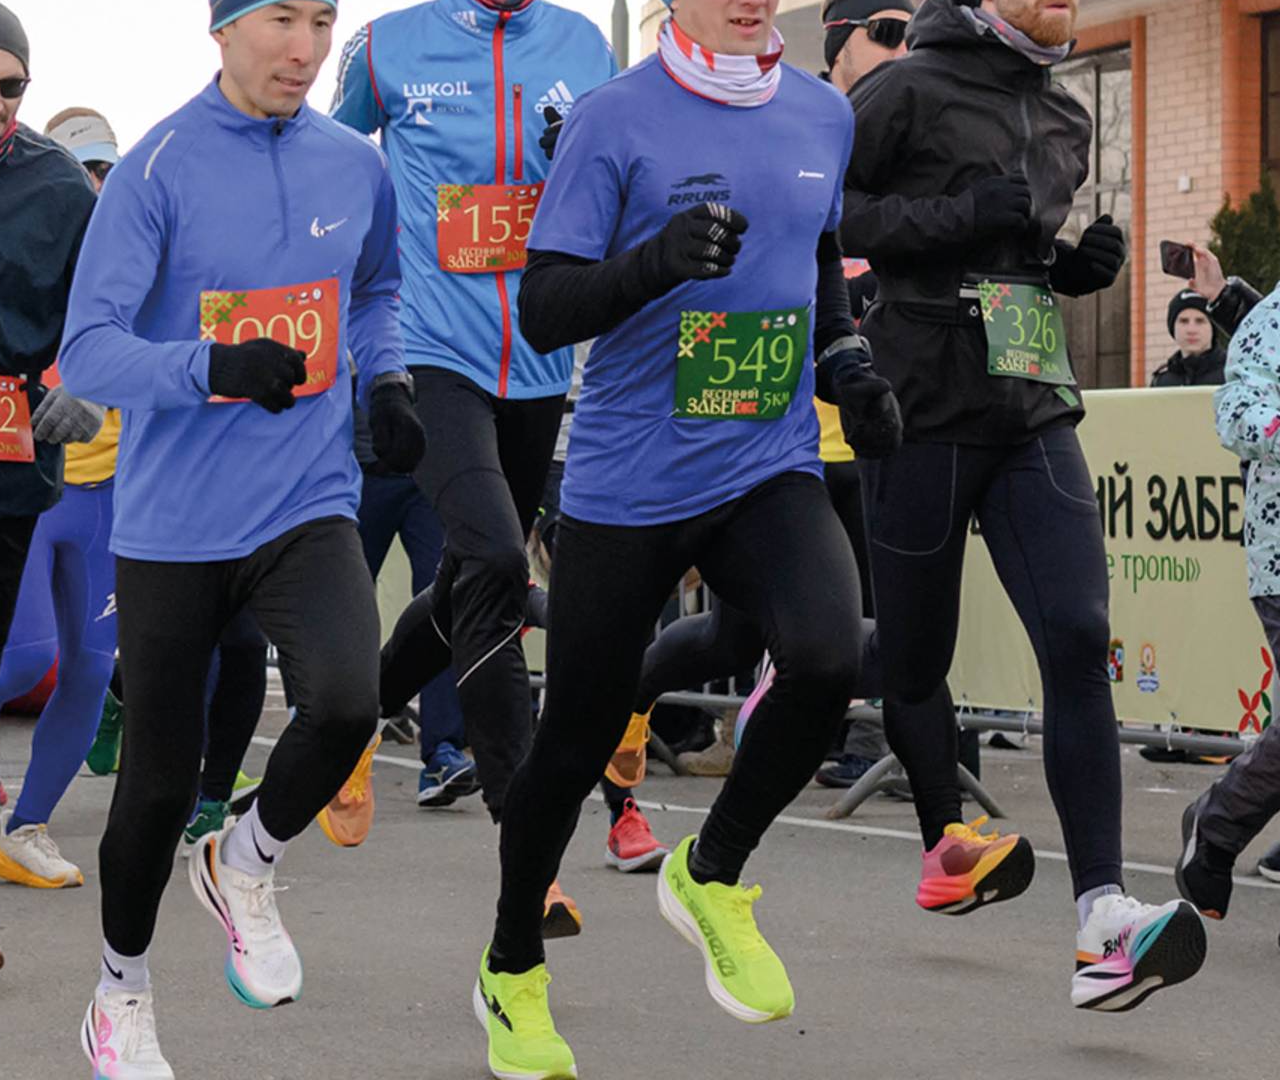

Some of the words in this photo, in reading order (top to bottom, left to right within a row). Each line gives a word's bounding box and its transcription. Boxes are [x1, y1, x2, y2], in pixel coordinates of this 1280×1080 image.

[402, 81, 472, 101] LUKOIL
[667, 190, 731, 206] RRUNS
[463, 203, 535, 243] 155
[1005, 304, 1056, 353] 326
[708, 334, 794, 384] 549
[686, 397, 736, 415] ЗАБЕГ
[1145, 474, 1244, 542] ЗАБЕ
